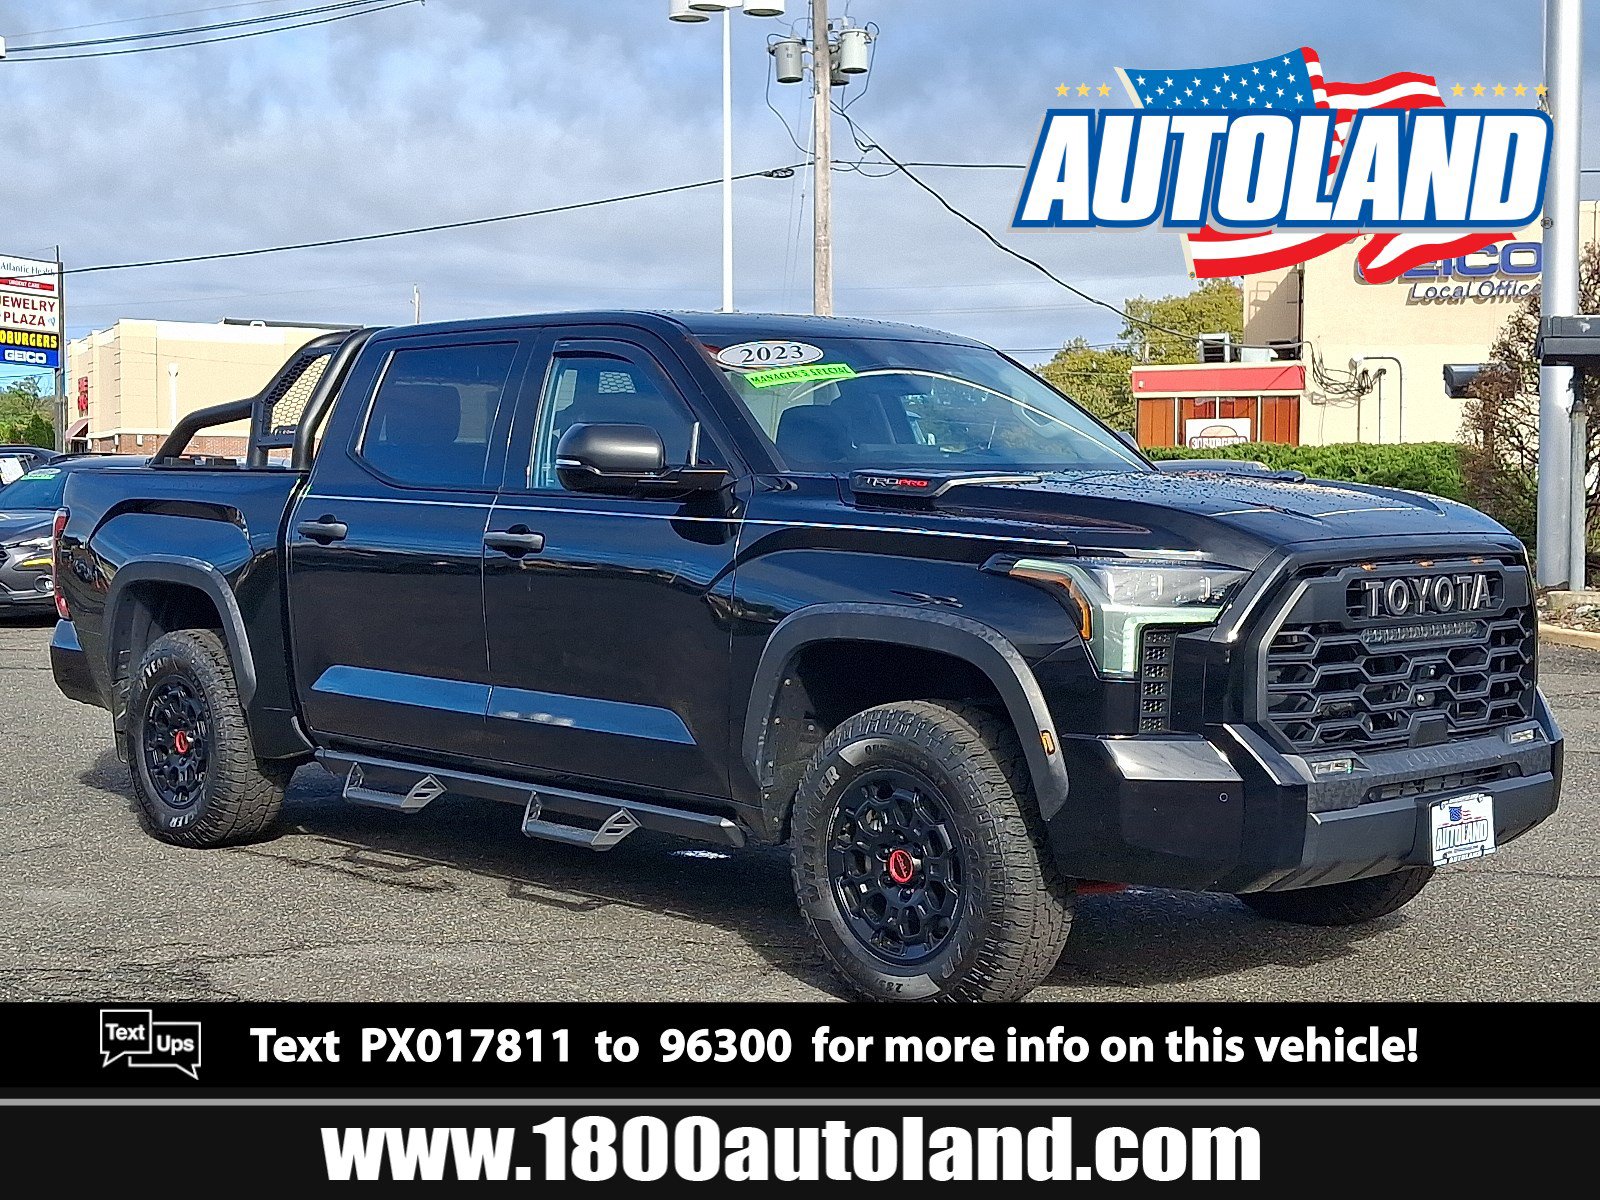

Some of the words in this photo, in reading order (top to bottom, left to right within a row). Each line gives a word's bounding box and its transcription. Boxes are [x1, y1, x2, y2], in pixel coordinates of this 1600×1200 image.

[1, 262, 30, 273] Atlantic
[1411, 281, 1470, 299] Local
[0, 295, 56, 312] EWELRY
[3, 311, 46, 327] PLAZA
[4, 349, 47, 364] GEICO
[739, 345, 804, 364] 2023
[810, 366, 852, 377] SPECIAL
[1361, 574, 1492, 617] TOYOTA
[1436, 818, 1489, 851] AUTOLAND
